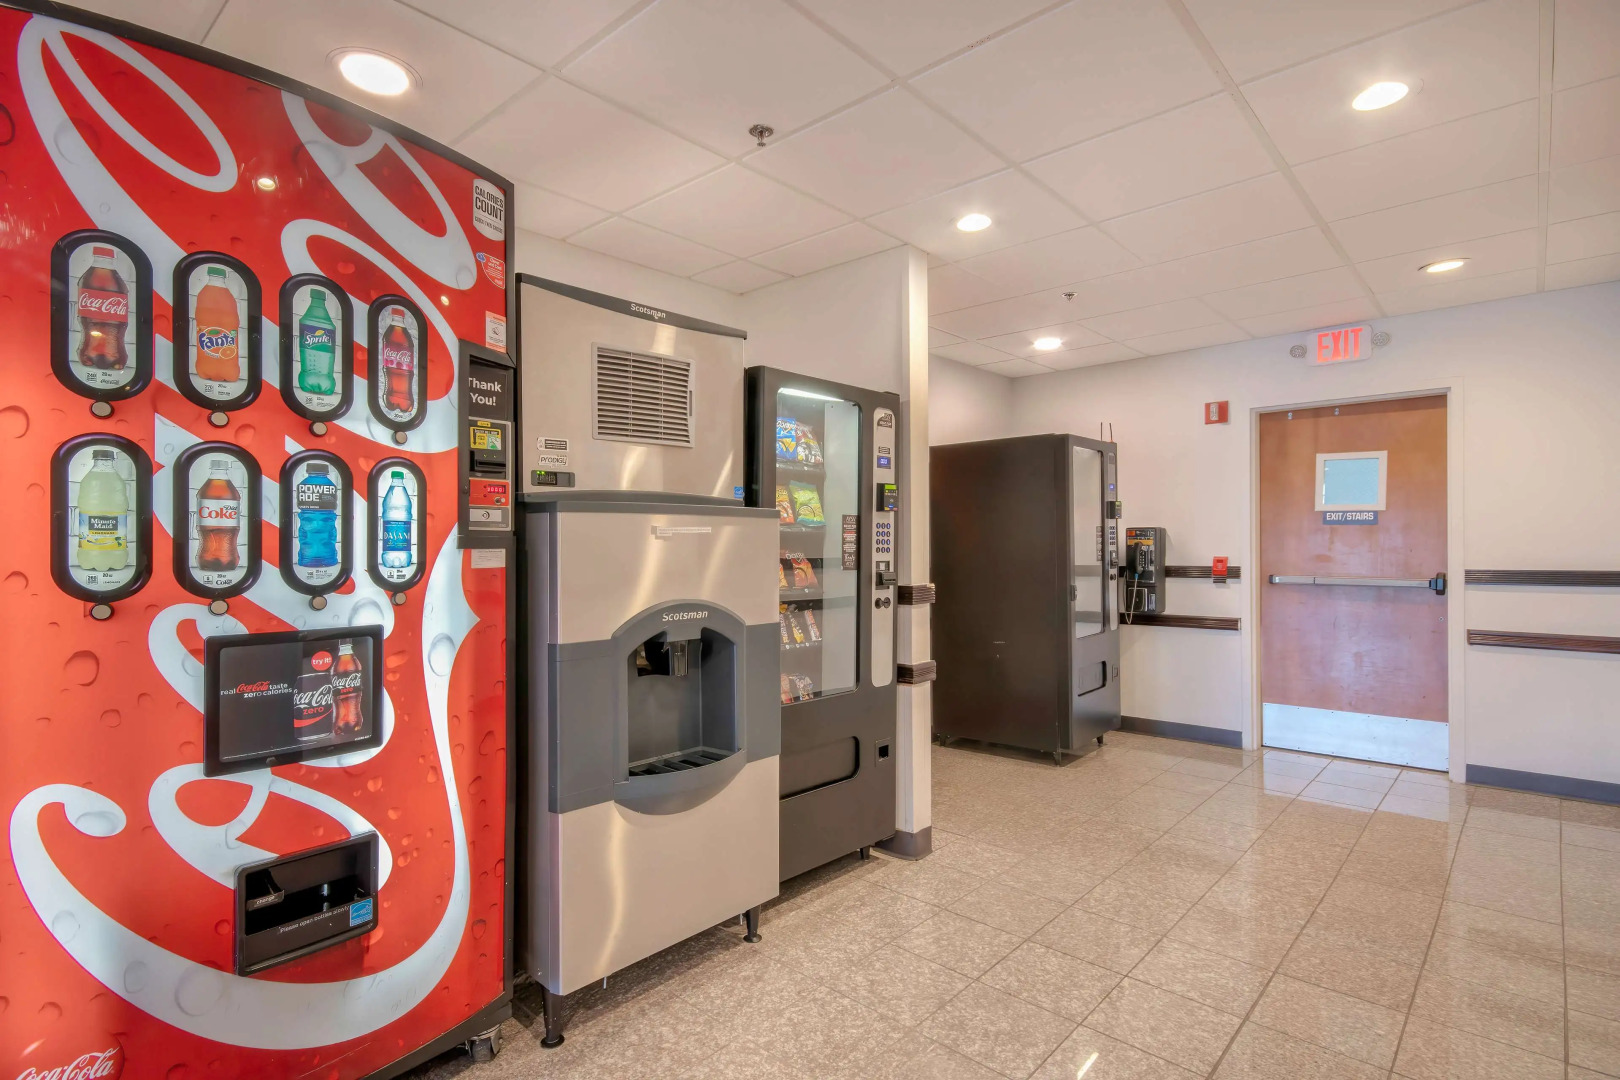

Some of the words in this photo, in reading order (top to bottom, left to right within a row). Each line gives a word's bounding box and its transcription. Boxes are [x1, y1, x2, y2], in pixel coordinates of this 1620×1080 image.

[474, 185, 504, 208] CALORIES
[475, 196, 504, 221] COUNT
[78, 292, 127, 316] Coca-Cola
[630, 303, 666, 319] Scotsman
[304, 333, 331, 347] Sprite
[1317, 327, 1363, 363] EXIT
[384, 347, 411, 363] Coca-Cola
[469, 377, 502, 393] Thank
[470, 392, 497, 406] You!
[298, 484, 336, 495] POWER
[198, 505, 238, 520] Coke
[1326, 512, 1374, 521] EXIT/STAIRS
[384, 530, 410, 541] DASANI
[662, 609, 708, 622] Scotsman
[312, 658, 324, 667] try
[331, 672, 361, 688] Coca-Cola
[220, 688, 236, 696] real
[236, 680, 270, 694] Coca-Cola
[269, 683, 289, 691] taste
[243, 691, 262, 699] zero
[262, 687, 293, 696] calories
[302, 706, 324, 716] zero
[280, 923, 299, 933] Please
[299, 917, 314, 928] open
